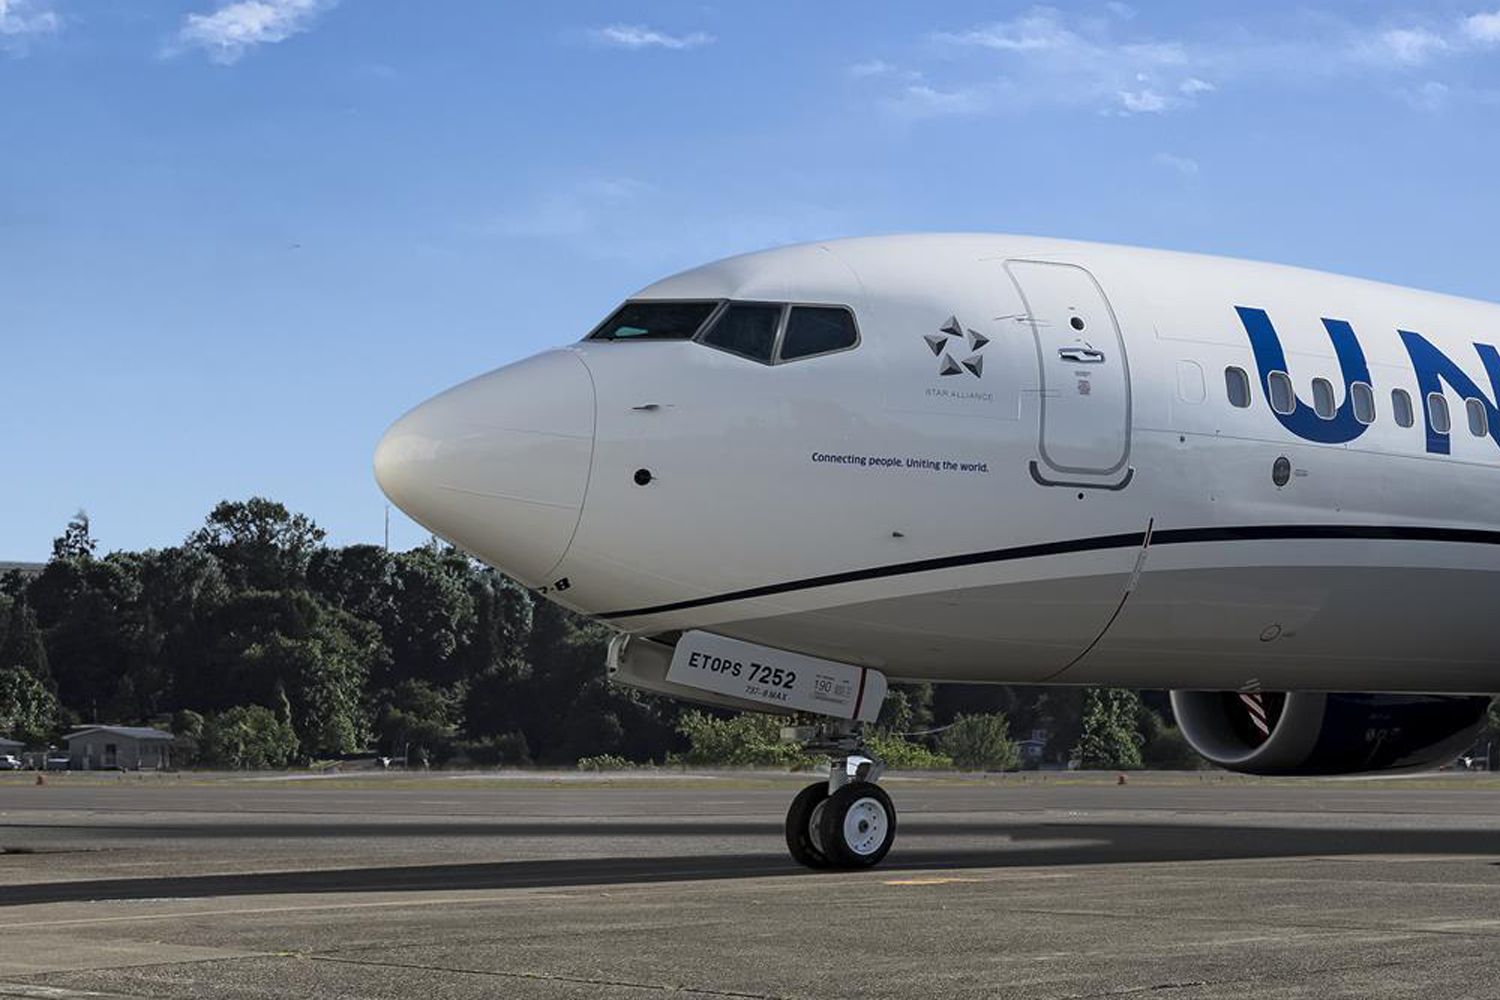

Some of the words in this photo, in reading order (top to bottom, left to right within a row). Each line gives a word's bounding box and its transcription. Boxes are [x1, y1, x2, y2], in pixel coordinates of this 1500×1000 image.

[812, 452, 866, 466] Connecting
[868, 456, 903, 468] people.
[906, 458, 940, 470] Uniting
[943, 460, 957, 470] the
[960, 462, 989, 472] world.
[688, 652, 742, 676] ETOPS
[747, 662, 796, 689] 7252
